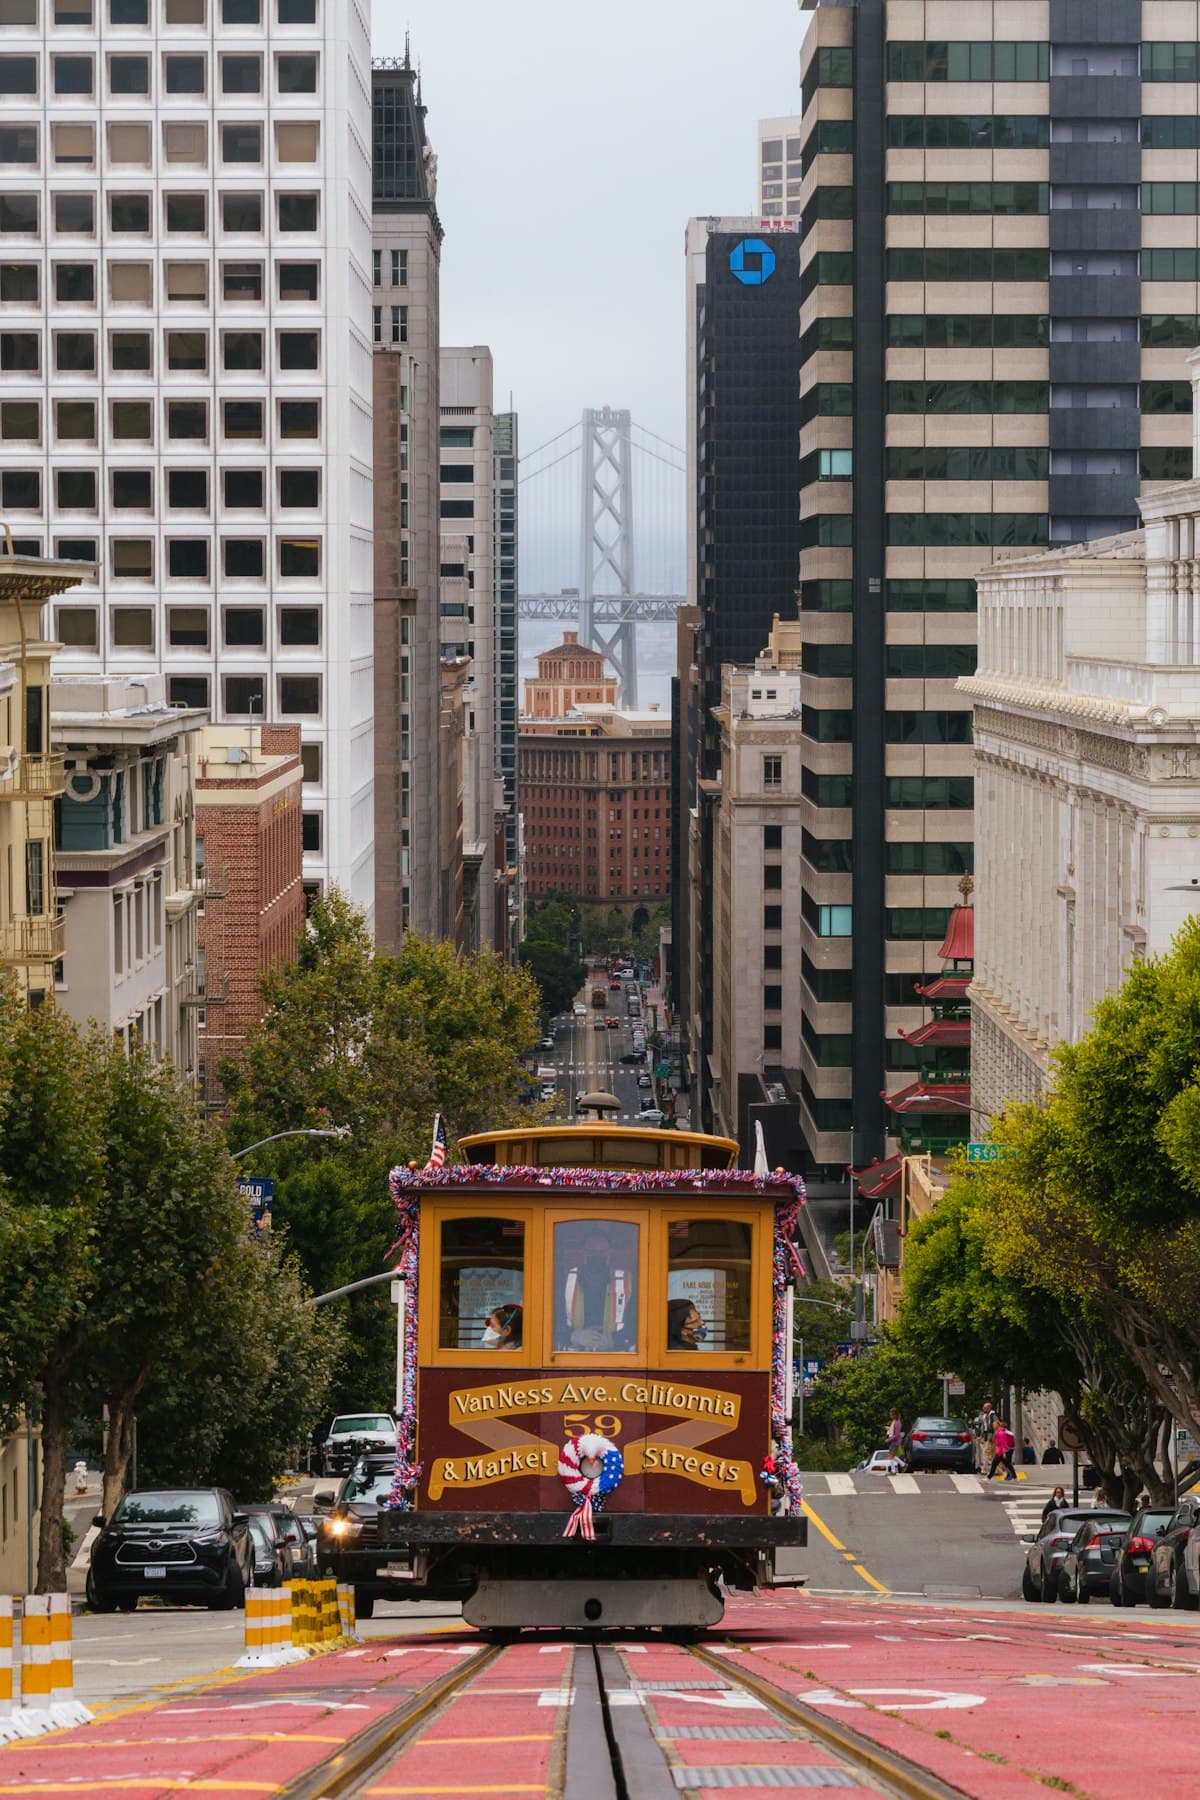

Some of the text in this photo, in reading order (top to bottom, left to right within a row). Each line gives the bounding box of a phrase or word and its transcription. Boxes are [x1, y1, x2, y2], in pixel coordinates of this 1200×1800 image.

[455, 1393, 495, 1415] Van
[497, 1386, 553, 1411] Ness
[620, 1382, 736, 1418] California
[564, 1414, 622, 1441] 59
[443, 1447, 740, 1483] & Market Streets
